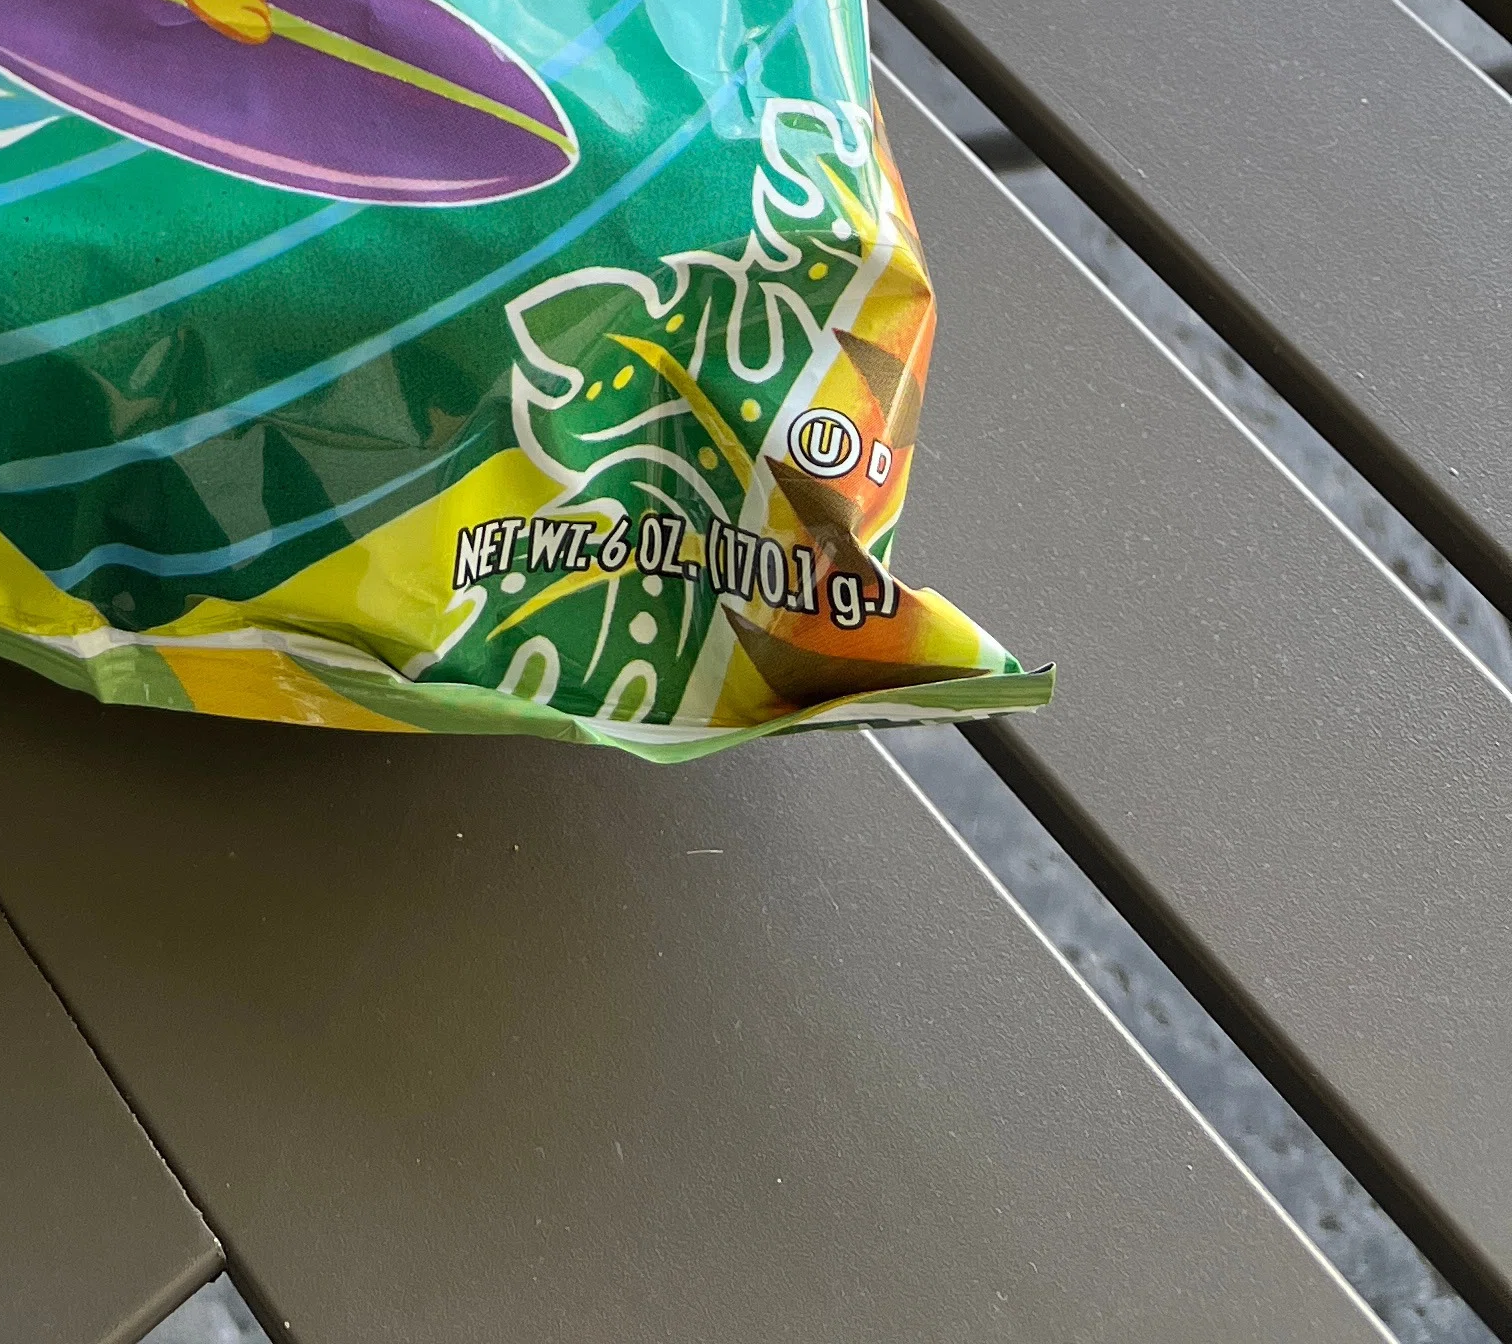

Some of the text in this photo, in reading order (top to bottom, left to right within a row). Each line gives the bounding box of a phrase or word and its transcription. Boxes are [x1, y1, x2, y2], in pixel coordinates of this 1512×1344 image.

[453, 516, 523, 590] NET
[526, 516, 592, 572] WT.
[597, 515, 632, 573] 6
[635, 513, 701, 580] OZ.
